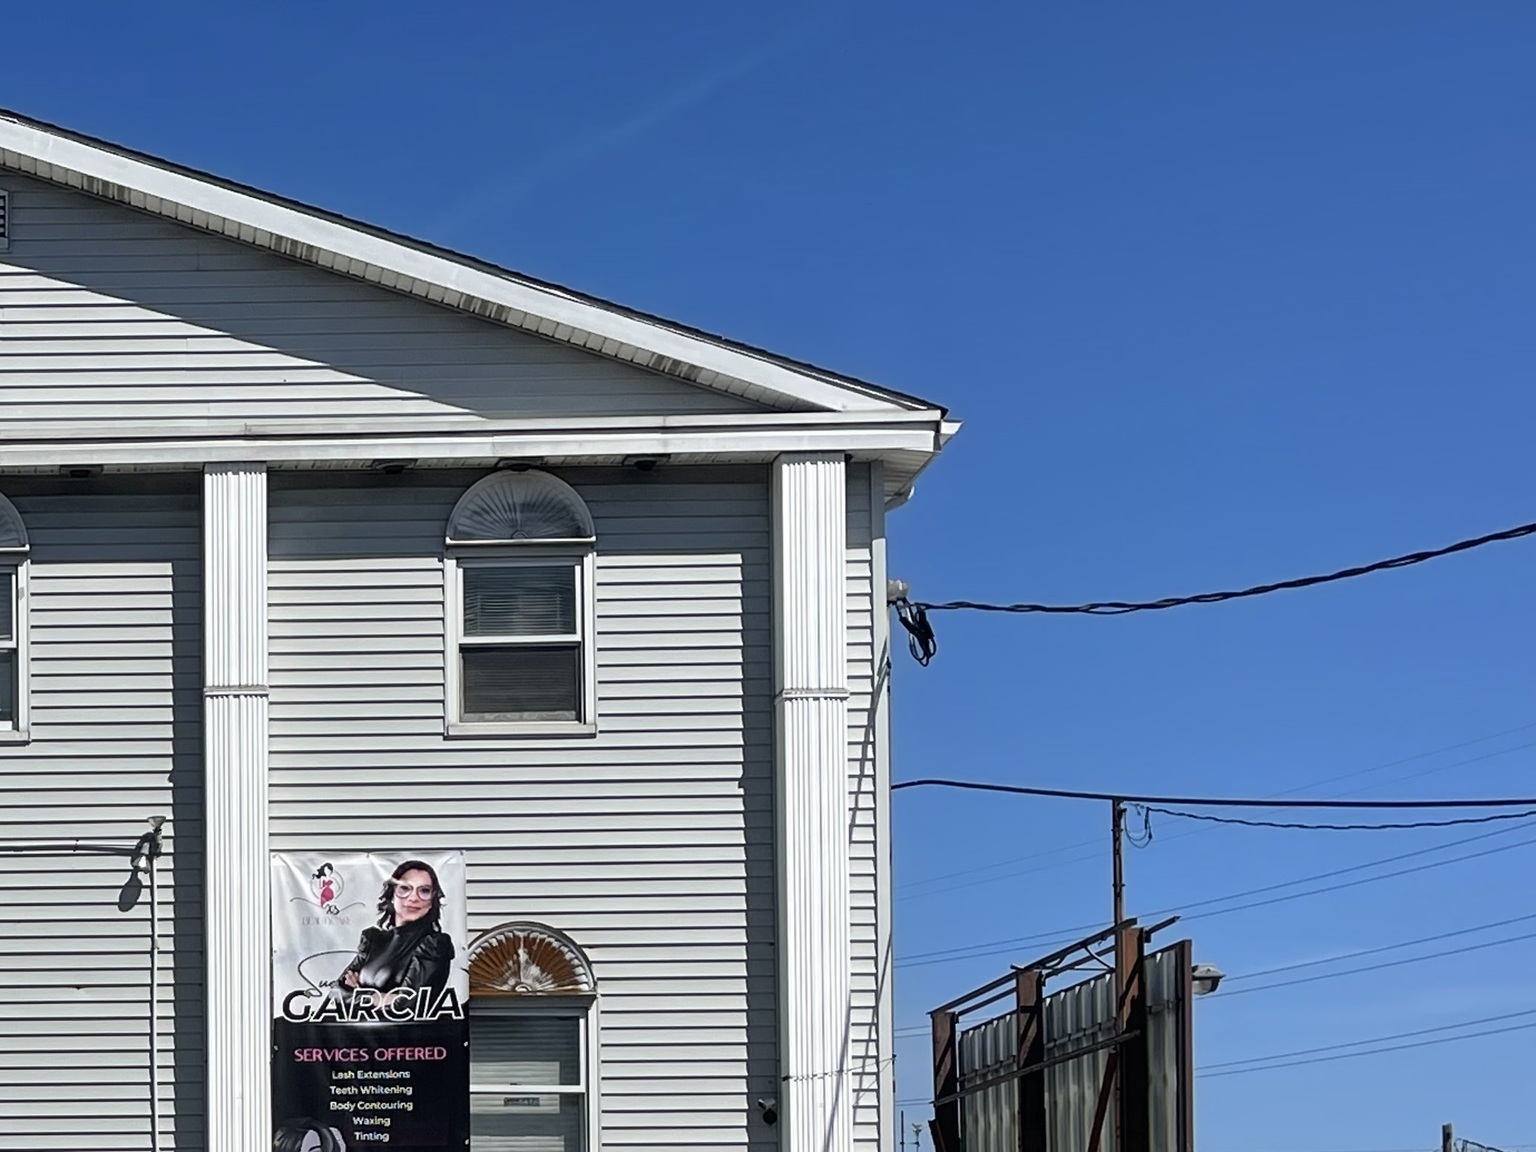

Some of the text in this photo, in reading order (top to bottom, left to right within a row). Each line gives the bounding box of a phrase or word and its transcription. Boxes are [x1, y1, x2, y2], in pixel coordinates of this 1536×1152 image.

[282, 985, 465, 1024] GARCIA
[293, 1046, 447, 1062] SERVICES OFFERED
[332, 1069, 411, 1079] Lash Extensions
[329, 1085, 413, 1096] Teeth Whitening
[330, 1101, 413, 1112] Body Contouring
[352, 1116, 390, 1127] Waxing
[354, 1131, 390, 1142] Tinting
